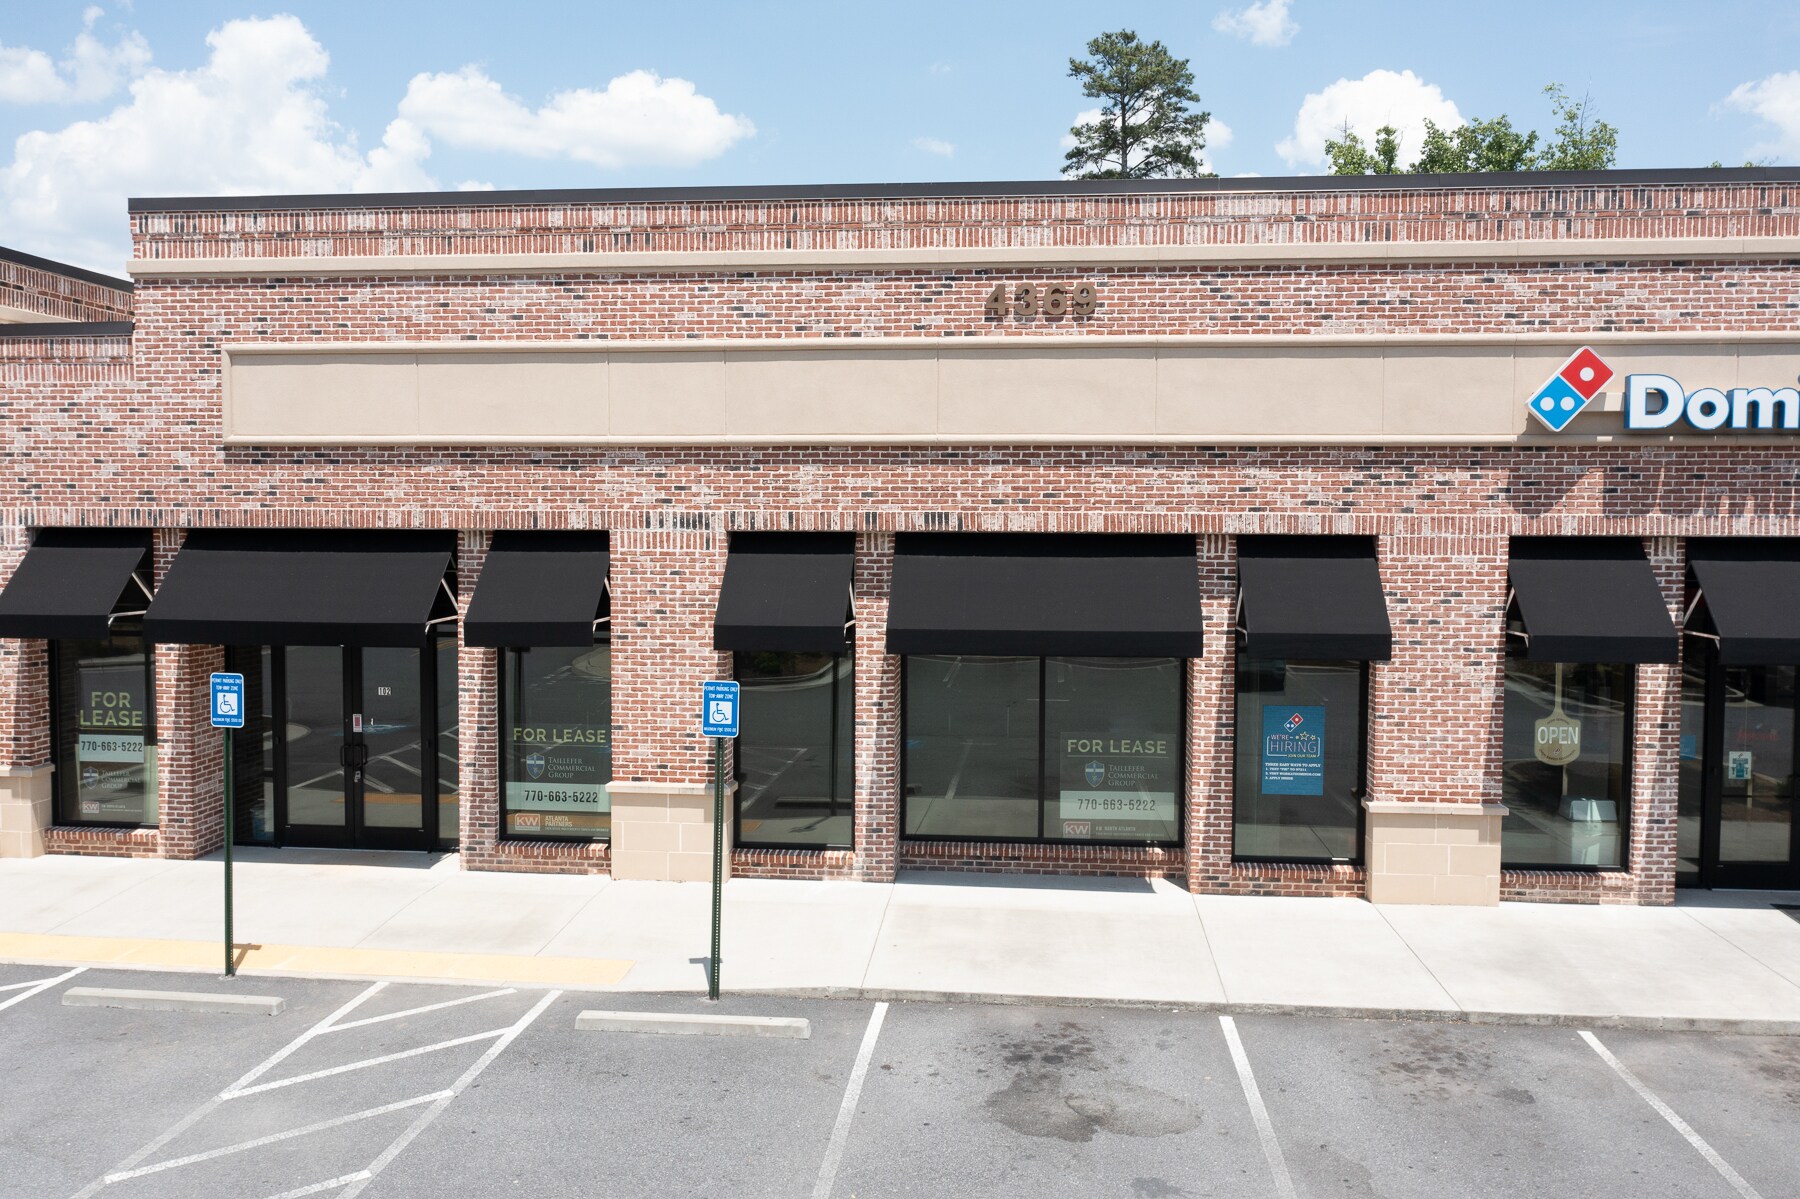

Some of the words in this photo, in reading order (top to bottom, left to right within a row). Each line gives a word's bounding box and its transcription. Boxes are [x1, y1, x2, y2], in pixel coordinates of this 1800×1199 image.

[985, 282, 1097, 316] 4369
[1625, 373, 1800, 430] Dom
[379, 687, 392, 696] 102
[91, 691, 131, 708] FOR
[80, 710, 143, 726] LEASE
[513, 728, 546, 742] FOR
[553, 728, 607, 742] LEASE
[1537, 726, 1579, 745] OPEN
[80, 740, 143, 752] 770-663-5222
[1067, 740, 1103, 752] FOR
[1110, 740, 1167, 754] LEASE
[1270, 741, 1317, 753] HIRING
[548, 756, 583, 764] TAILLEFER
[548, 764, 596, 772] COMMERCIAL
[1108, 772, 1159, 780] COMMERCIAL
[524, 790, 598, 802] 770-663-5222
[82, 802, 98, 811] KW
[1078, 798, 1156, 811] 770-663-5222
[516, 816, 538, 826] KW
[1065, 825, 1089, 834] KW
